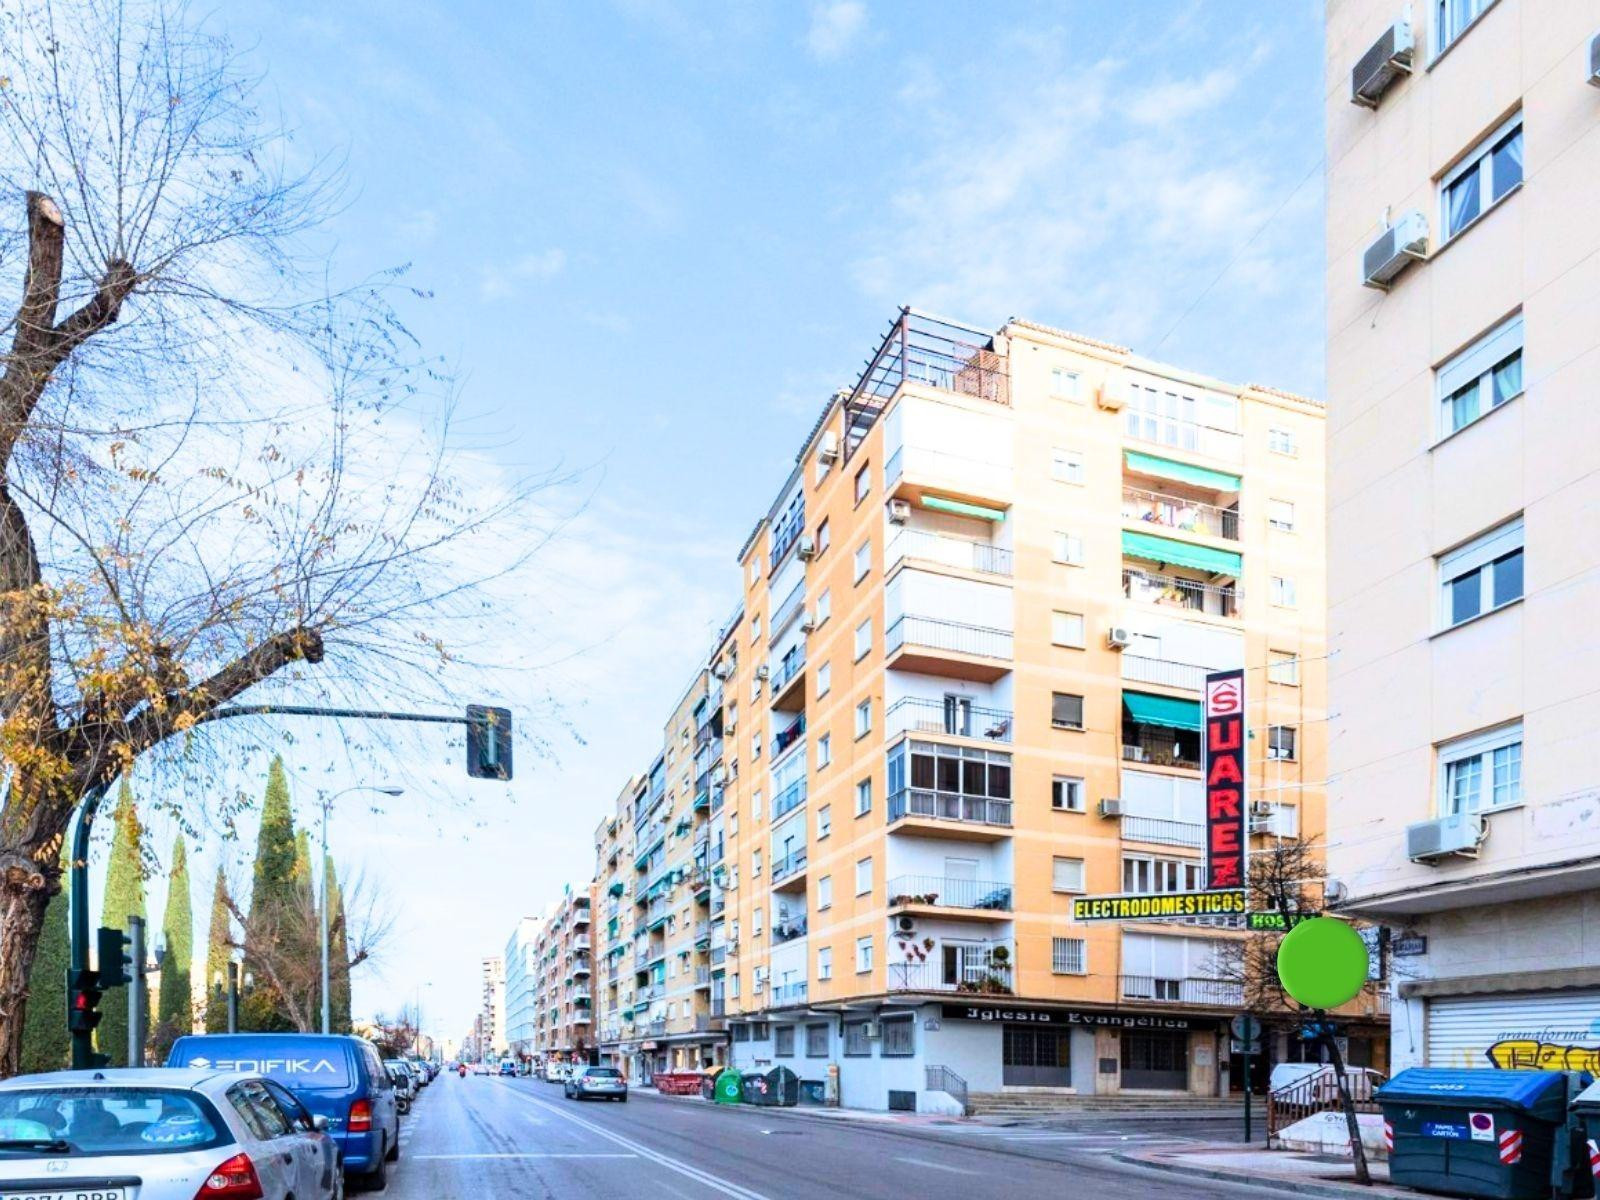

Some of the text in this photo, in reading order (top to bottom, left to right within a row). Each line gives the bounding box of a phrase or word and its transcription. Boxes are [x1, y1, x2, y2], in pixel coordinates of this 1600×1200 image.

[1075, 893, 1244, 918] ELECTRODOMESTICOS
[967, 1007, 1050, 1022] Iglesia
[215, 1058, 337, 1073] EDIFIKA
